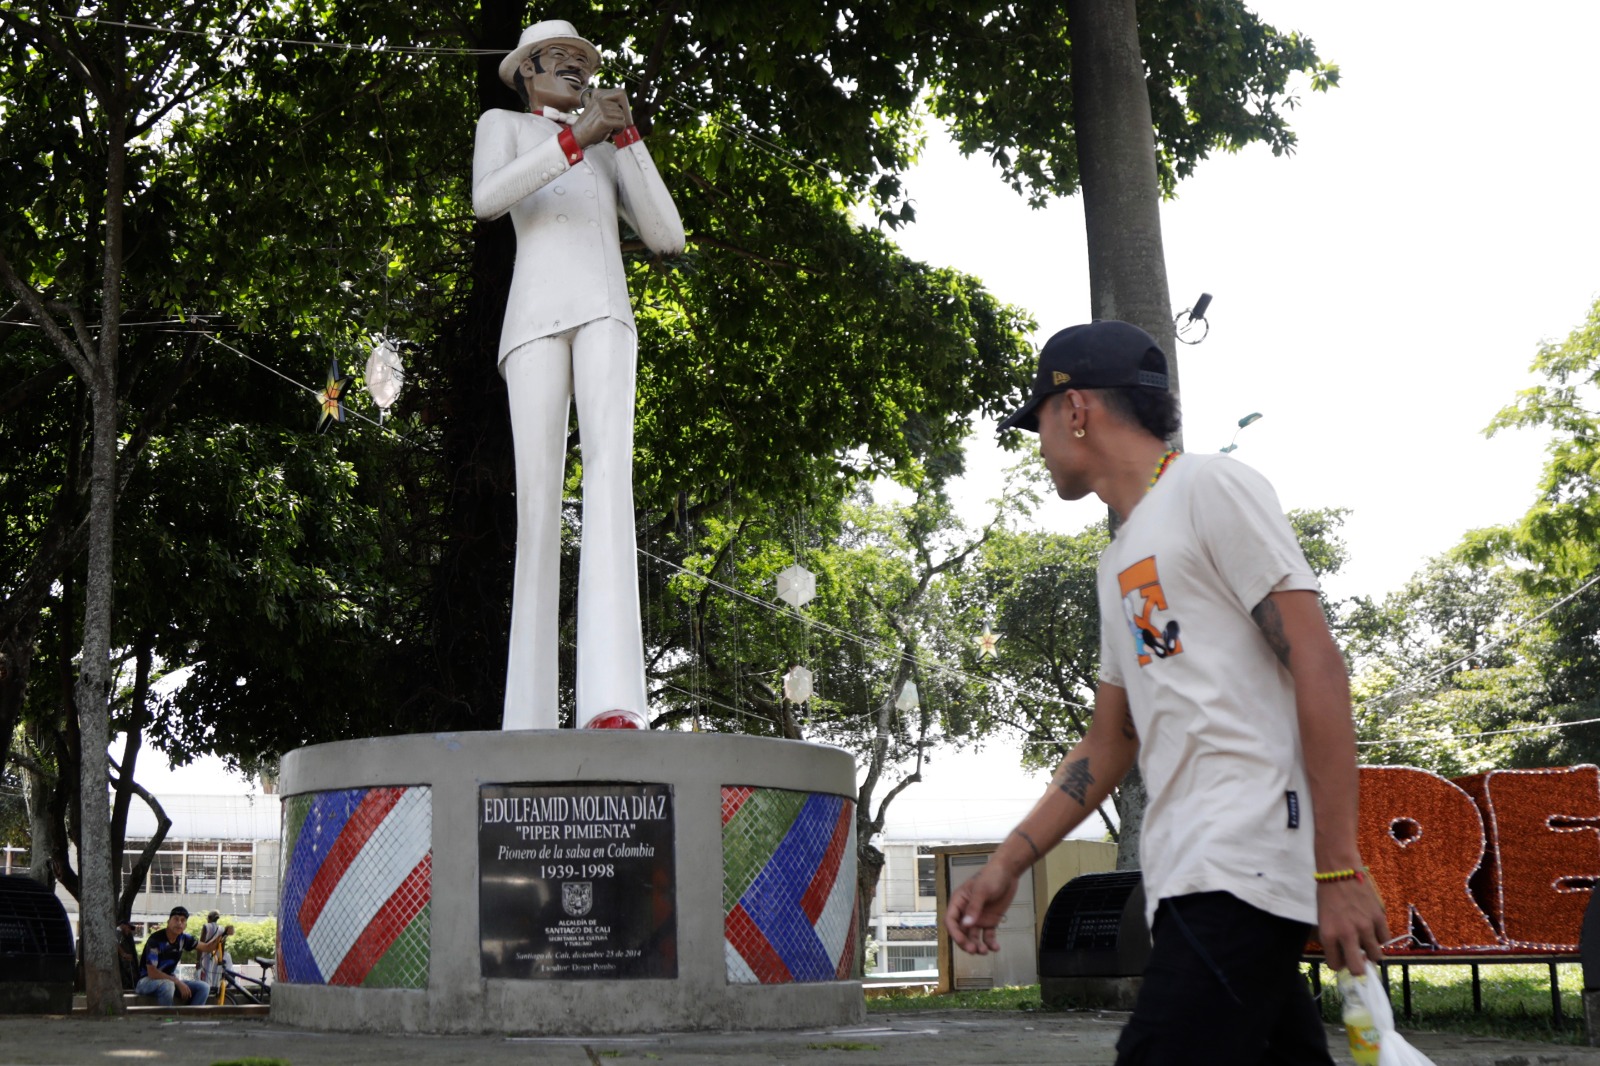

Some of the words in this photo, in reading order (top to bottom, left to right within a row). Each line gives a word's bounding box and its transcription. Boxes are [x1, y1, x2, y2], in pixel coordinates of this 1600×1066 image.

[484, 797, 569, 823] EDULFAMID
[572, 796, 629, 822] MOLINA
[632, 788, 667, 820] DÍAZ
[515, 825, 561, 840] "PIPER
[564, 823, 636, 840] PIMIENTA"
[498, 845, 537, 860] Pionero
[538, 844, 551, 859] de
[553, 844, 563, 859] la
[565, 844, 591, 859] salsa
[593, 847, 605, 858] en
[607, 842, 655, 858] Colombia
[540, 864, 615, 879] 1939-1998
[545, 927, 581, 935] SANTIAGO
[583, 926, 593, 934] DE
[595, 926, 611, 934] CALI
[515, 952, 545, 961] Santiago
[545, 951, 553, 960] de
[555, 951, 571, 960] Cali,
[572, 950, 604, 959] diciembre
[615, 950, 624, 958] de
[625, 949, 641, 958] 2014
